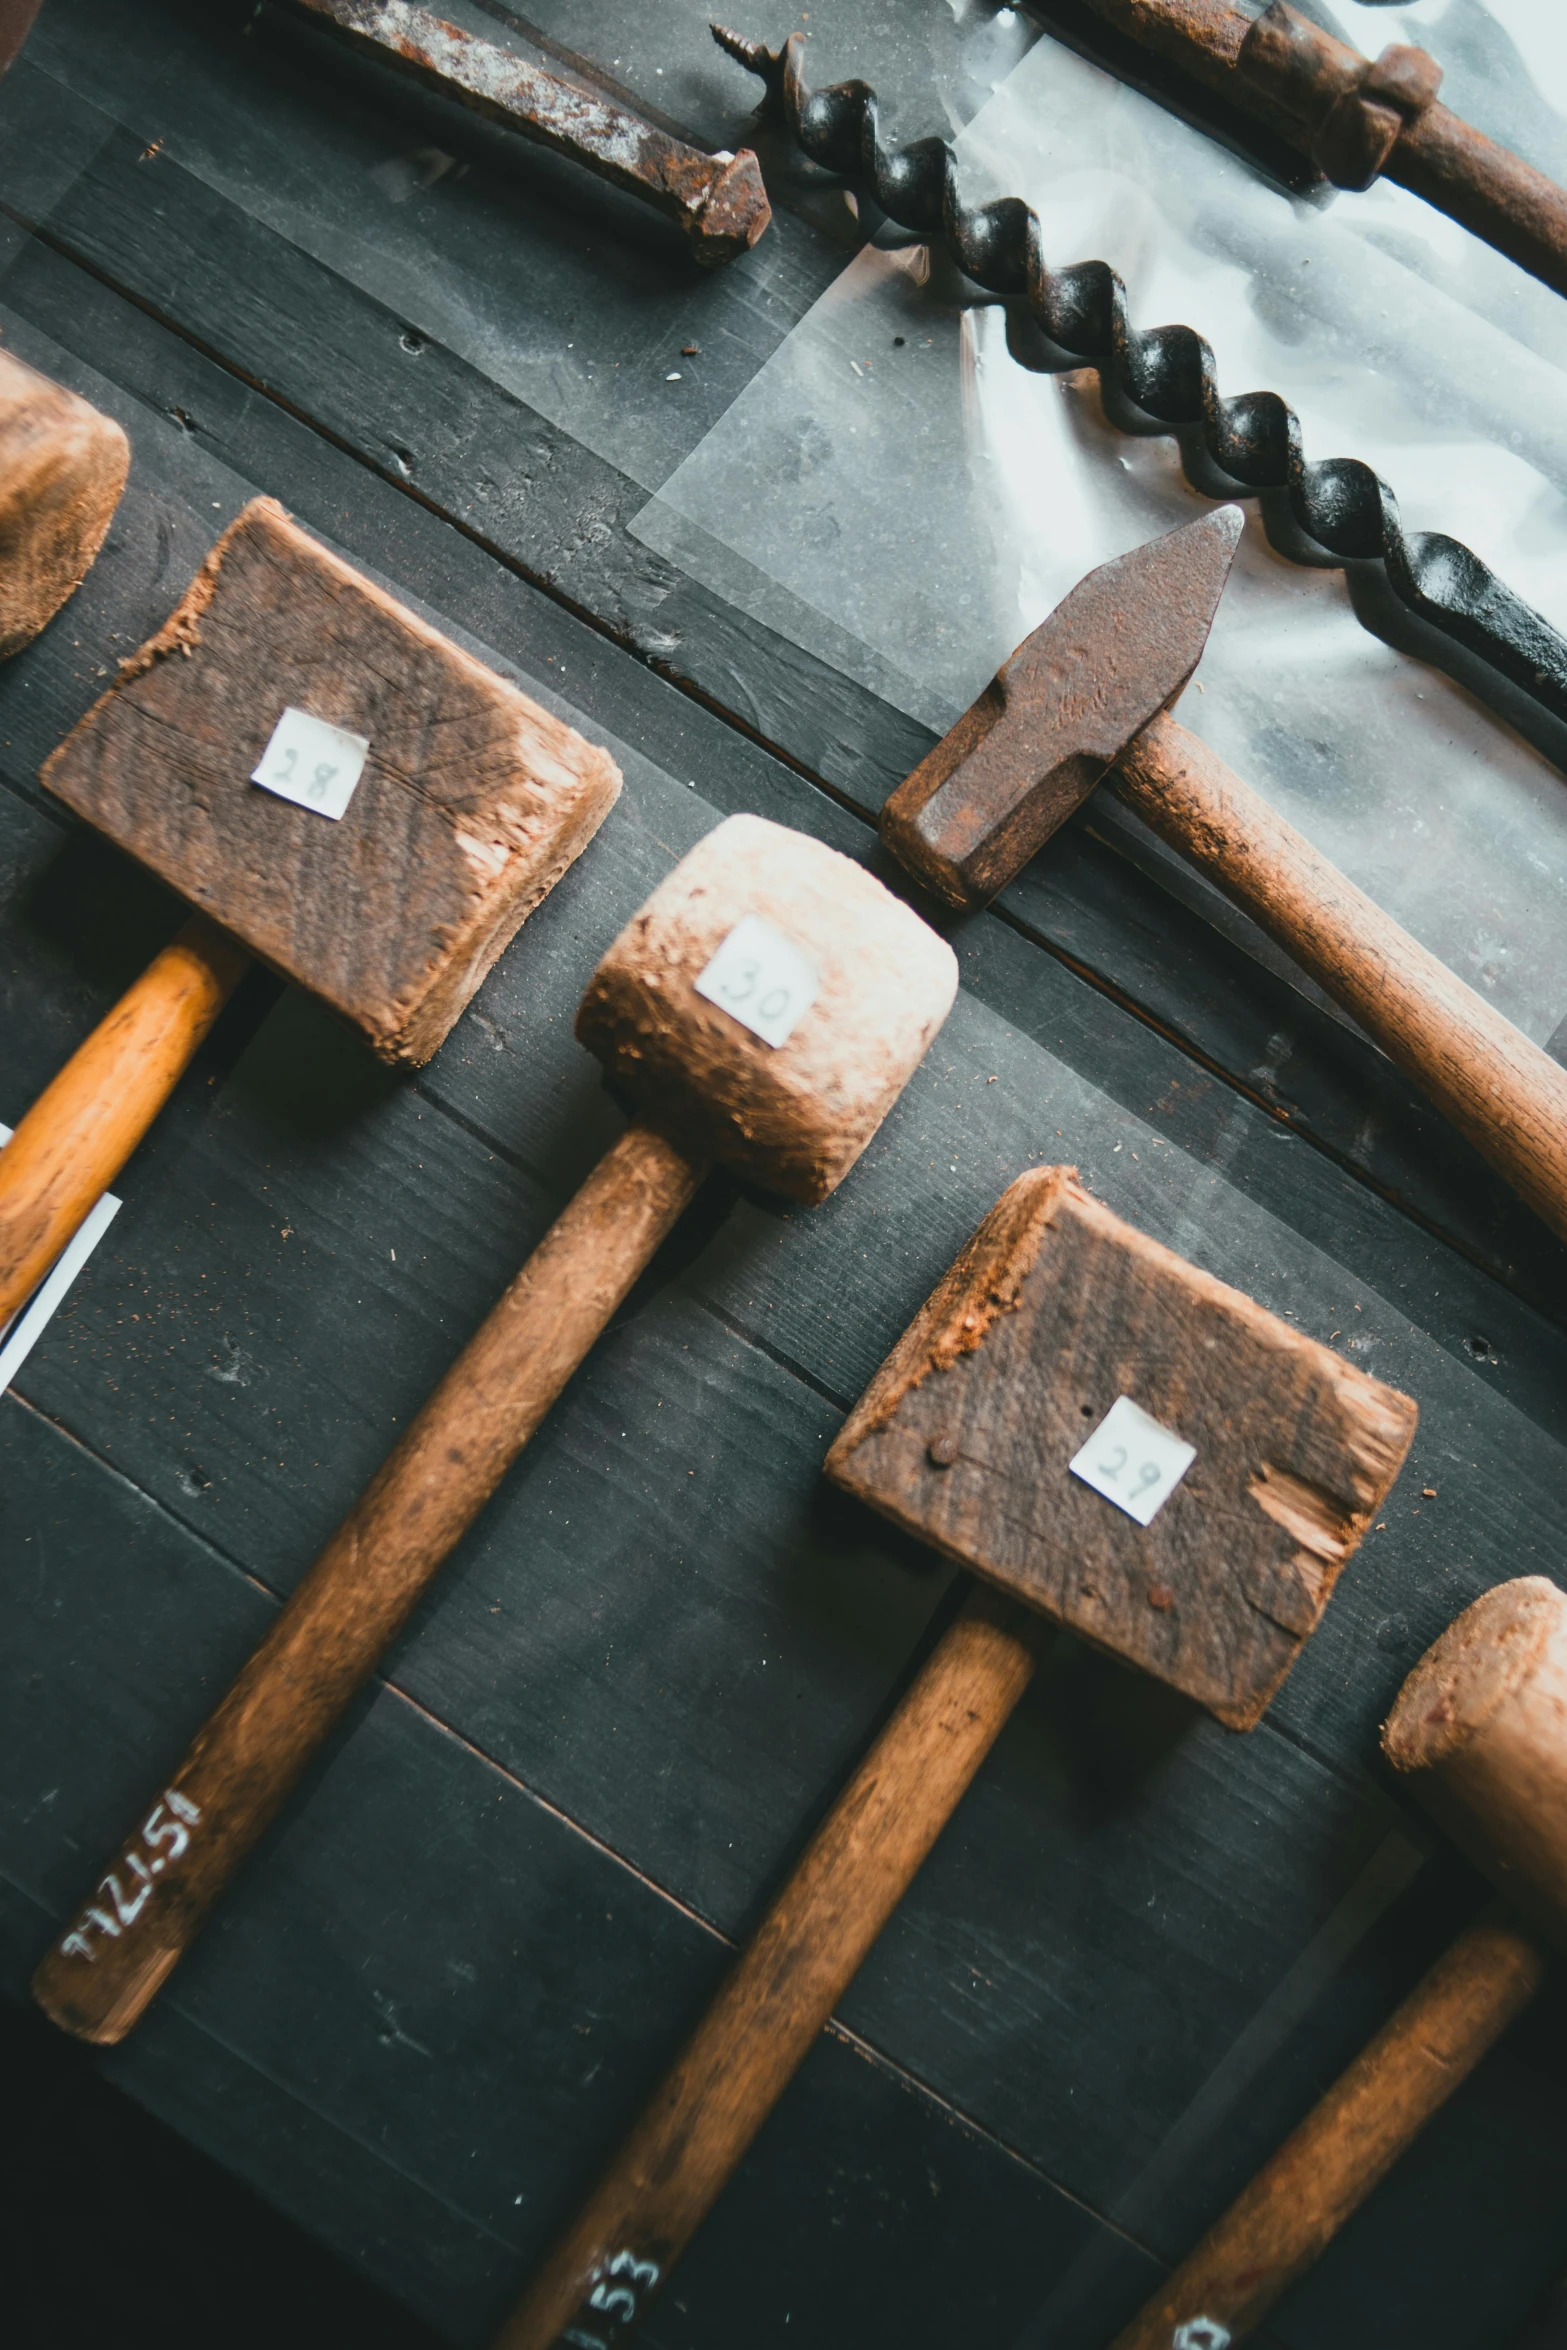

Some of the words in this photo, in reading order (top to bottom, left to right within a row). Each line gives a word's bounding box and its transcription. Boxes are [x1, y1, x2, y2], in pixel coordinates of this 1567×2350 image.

[272, 747, 339, 801] 28
[720, 957, 791, 1022] 30
[1097, 1444, 1161, 1501] 29
